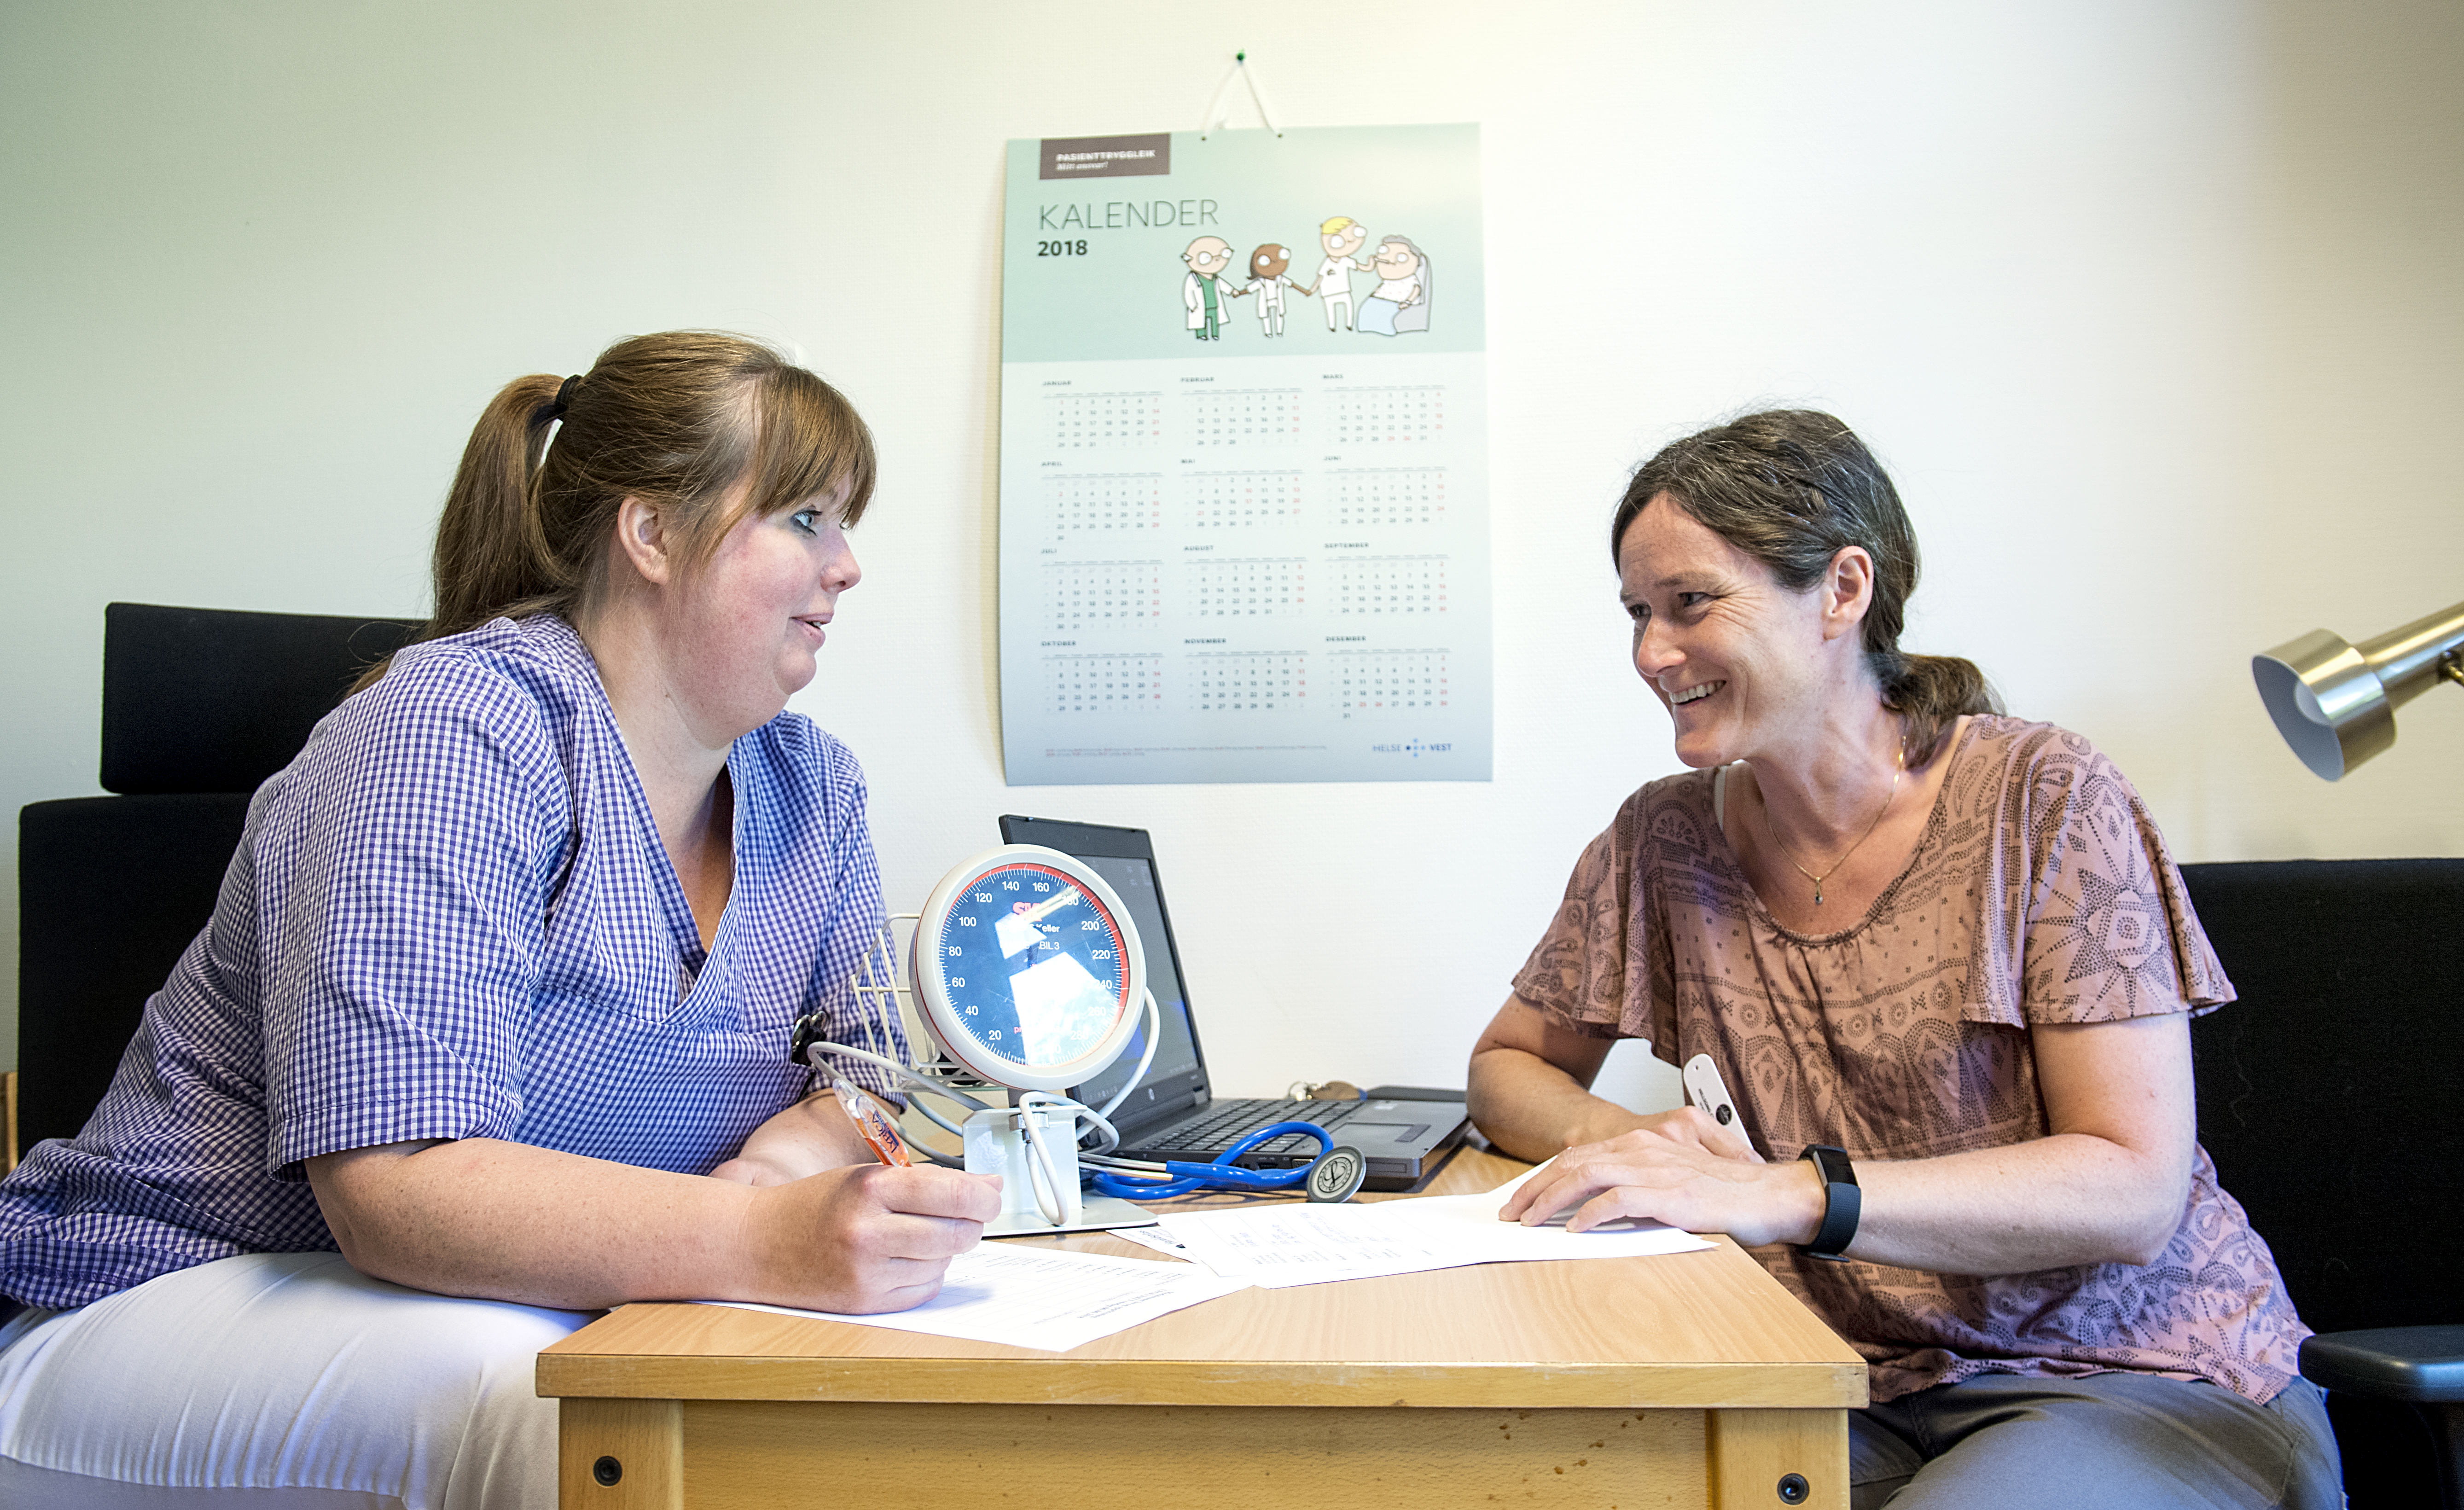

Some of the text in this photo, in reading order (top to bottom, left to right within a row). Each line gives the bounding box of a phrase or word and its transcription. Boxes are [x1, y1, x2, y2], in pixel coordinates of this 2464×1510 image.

[1040, 199, 1218, 229] KALENDER
[1038, 239, 1087, 256] 2018
[1372, 743, 1452, 752] HELSE VEST
[1002, 881, 1020, 891] 140
[1033, 882, 1050, 893] 160
[975, 893, 993, 903] 120
[1062, 896, 1079, 906] 180
[959, 917, 977, 927] 100
[1081, 920, 1100, 930] 200
[949, 947, 962, 957] 80
[1093, 950, 1110, 959] 220
[952, 977, 965, 987] 60
[1094, 979, 1112, 989] 240
[965, 1005, 978, 1016] 40
[1088, 1006, 1106, 1016] 260
[988, 1030, 1002, 1040] 20
[1070, 1030, 1089, 1040] 280
